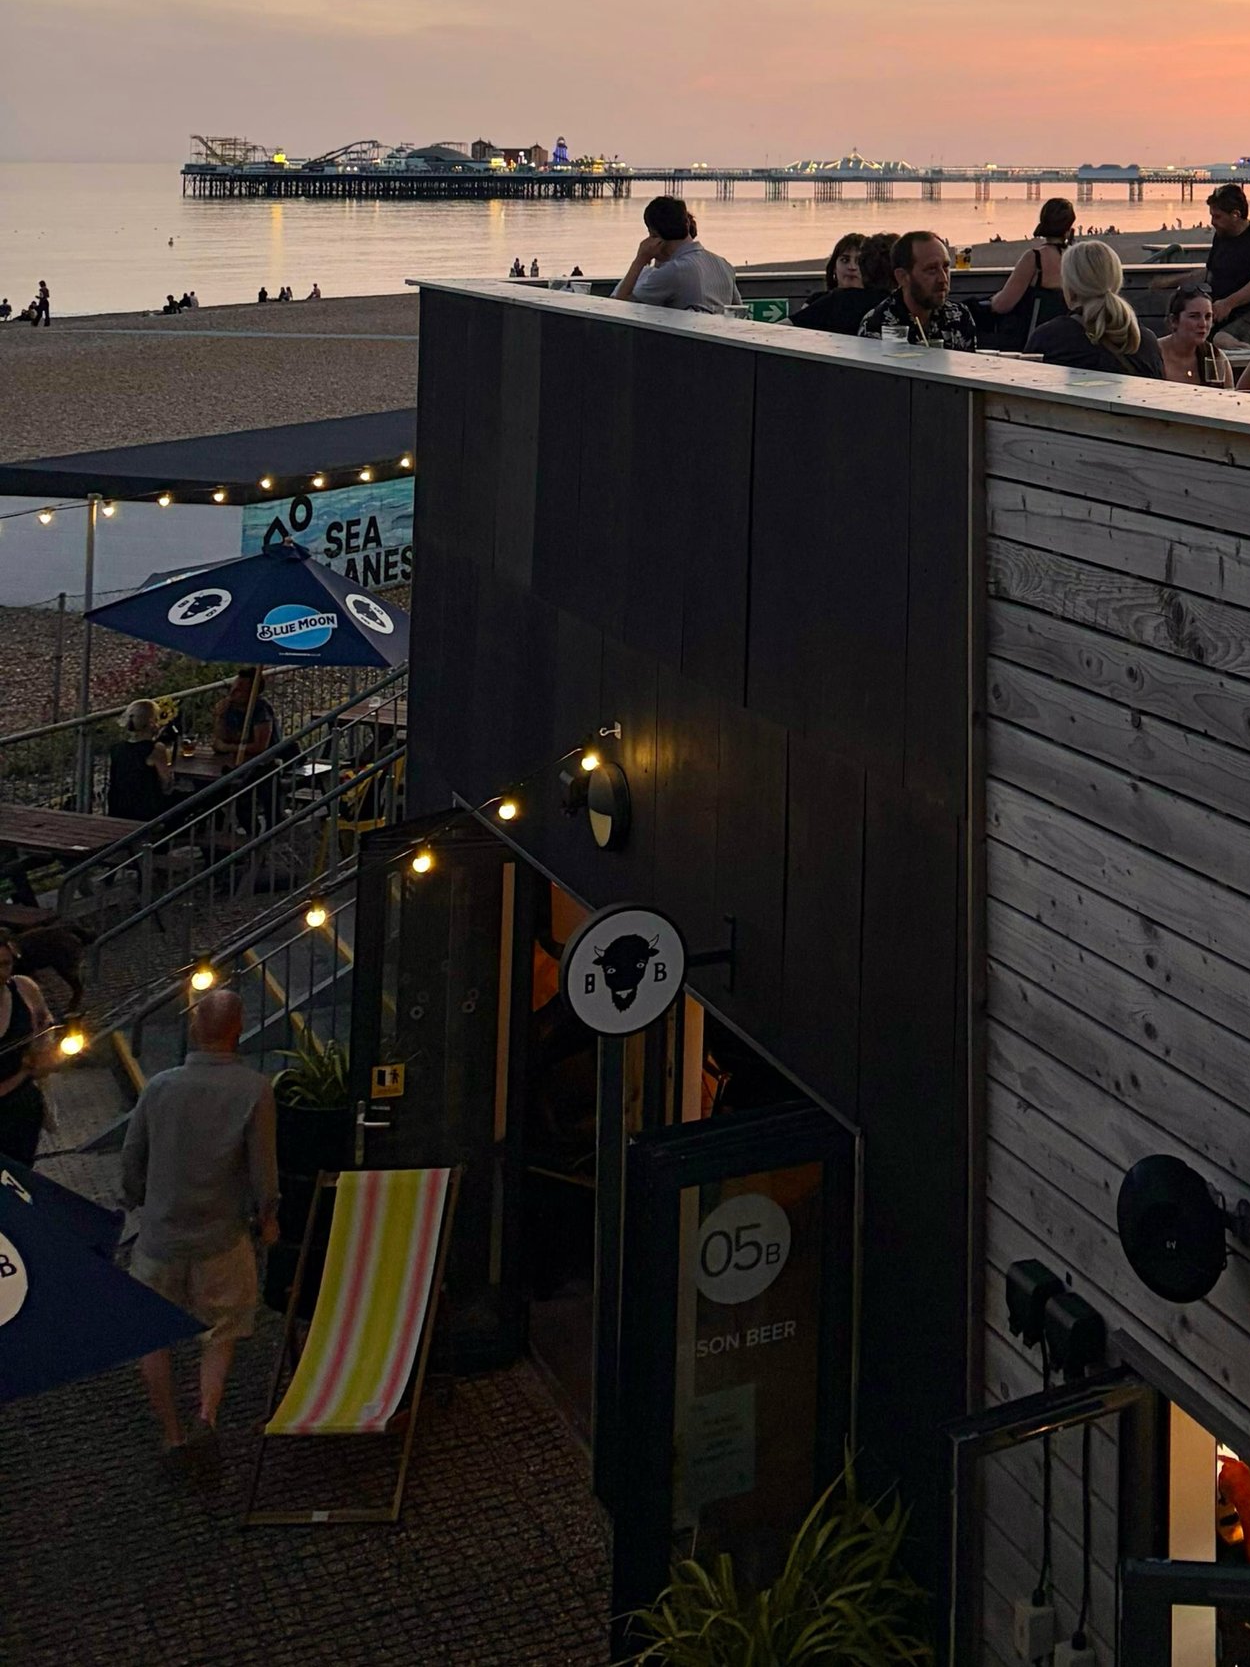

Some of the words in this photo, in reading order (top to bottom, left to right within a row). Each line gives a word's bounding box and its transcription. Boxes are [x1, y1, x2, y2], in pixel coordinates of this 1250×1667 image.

[324, 515, 382, 559] SEA
[325, 545, 413, 587] ANES
[258, 621, 297, 639] BLUE
[298, 613, 336, 632] MOON
[584, 972, 596, 995] B
[653, 961, 668, 983] B
[745, 1320, 798, 1347] BEER
